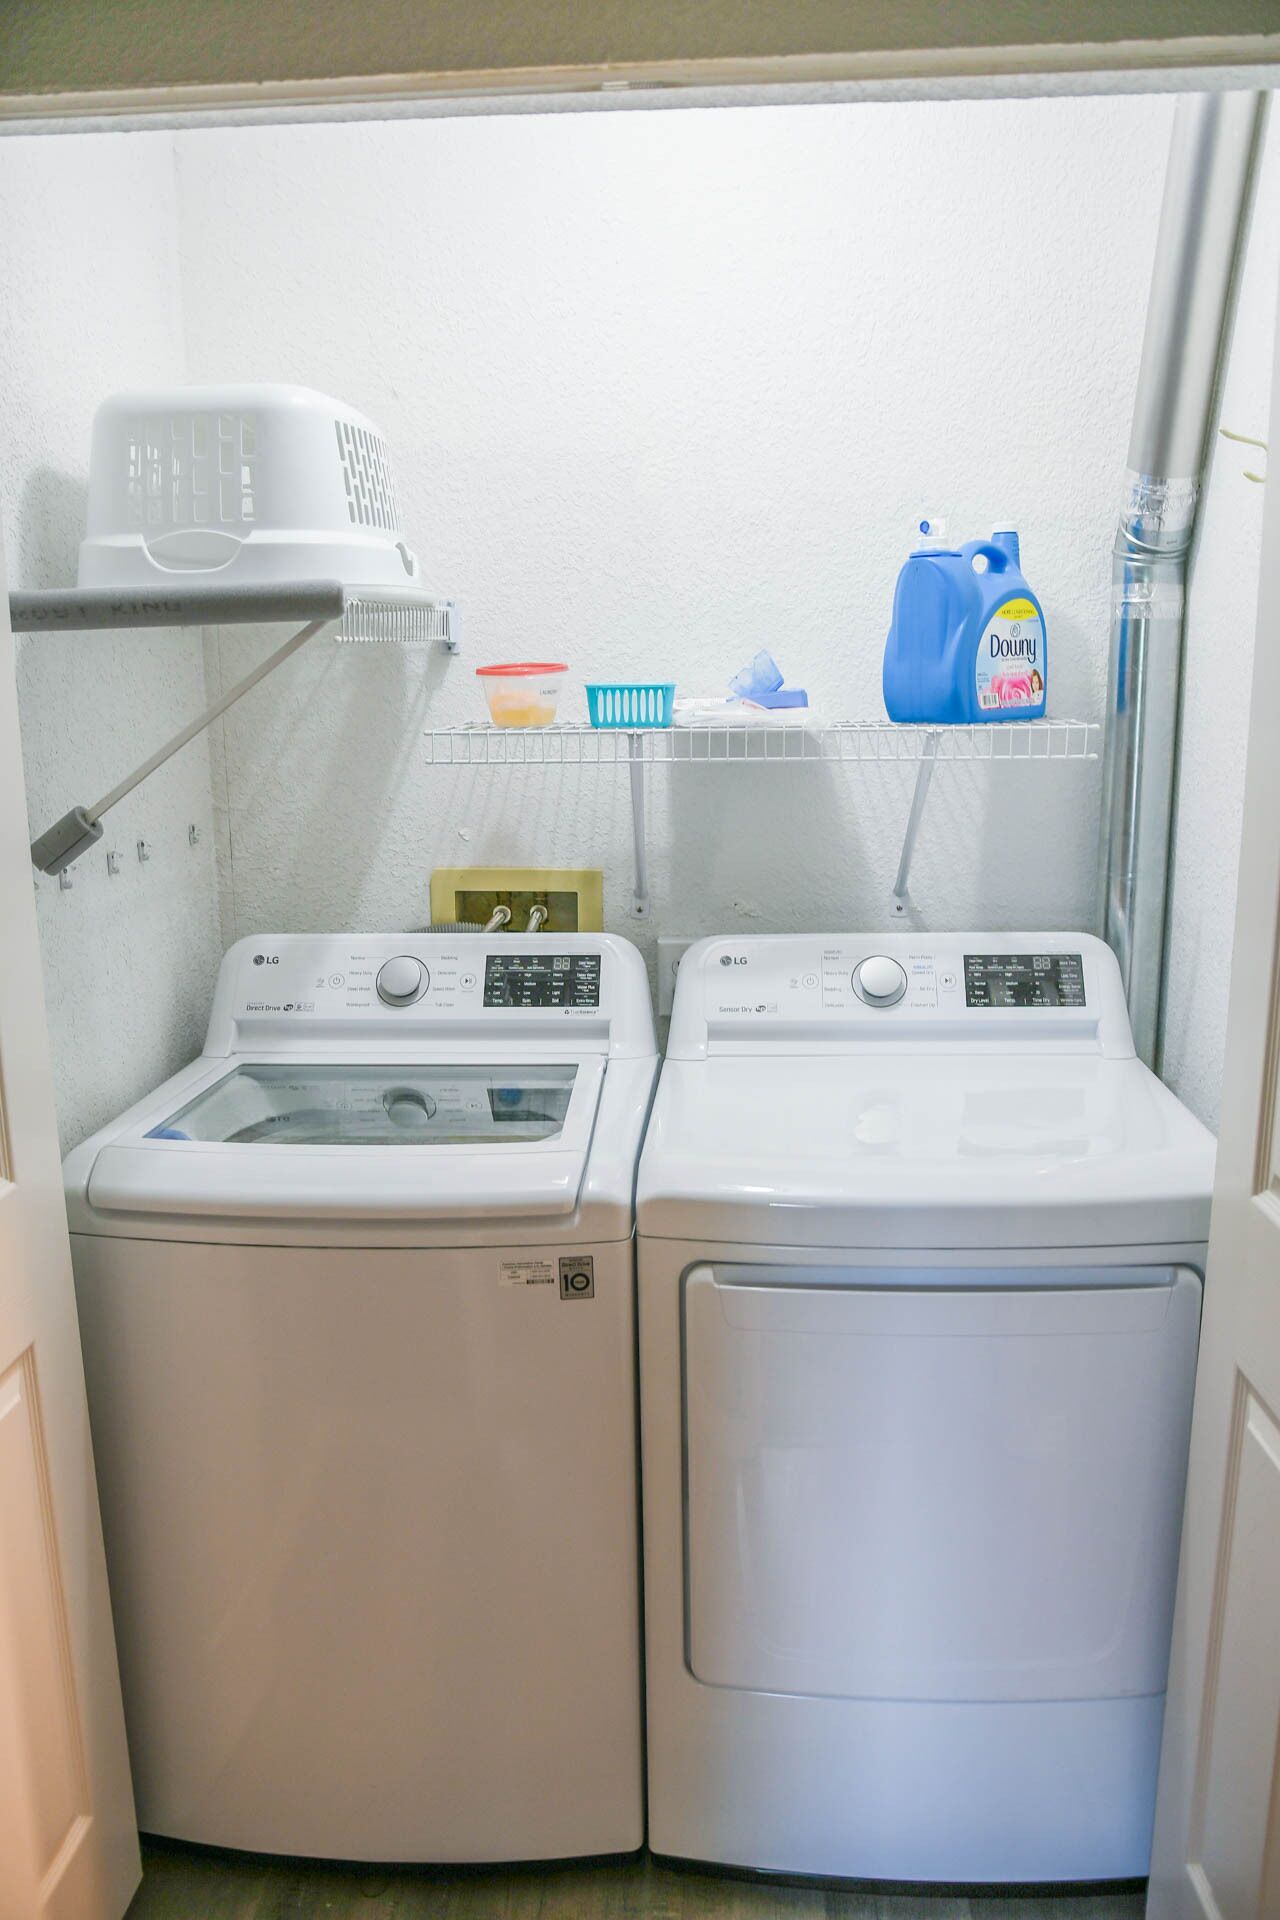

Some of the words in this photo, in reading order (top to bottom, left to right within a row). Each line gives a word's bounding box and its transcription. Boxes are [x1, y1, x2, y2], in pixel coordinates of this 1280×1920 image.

[990, 634, 1036, 664] Downy
[266, 956, 280, 964] LG
[734, 956, 748, 966] LG
[564, 1273, 590, 1292] 10
